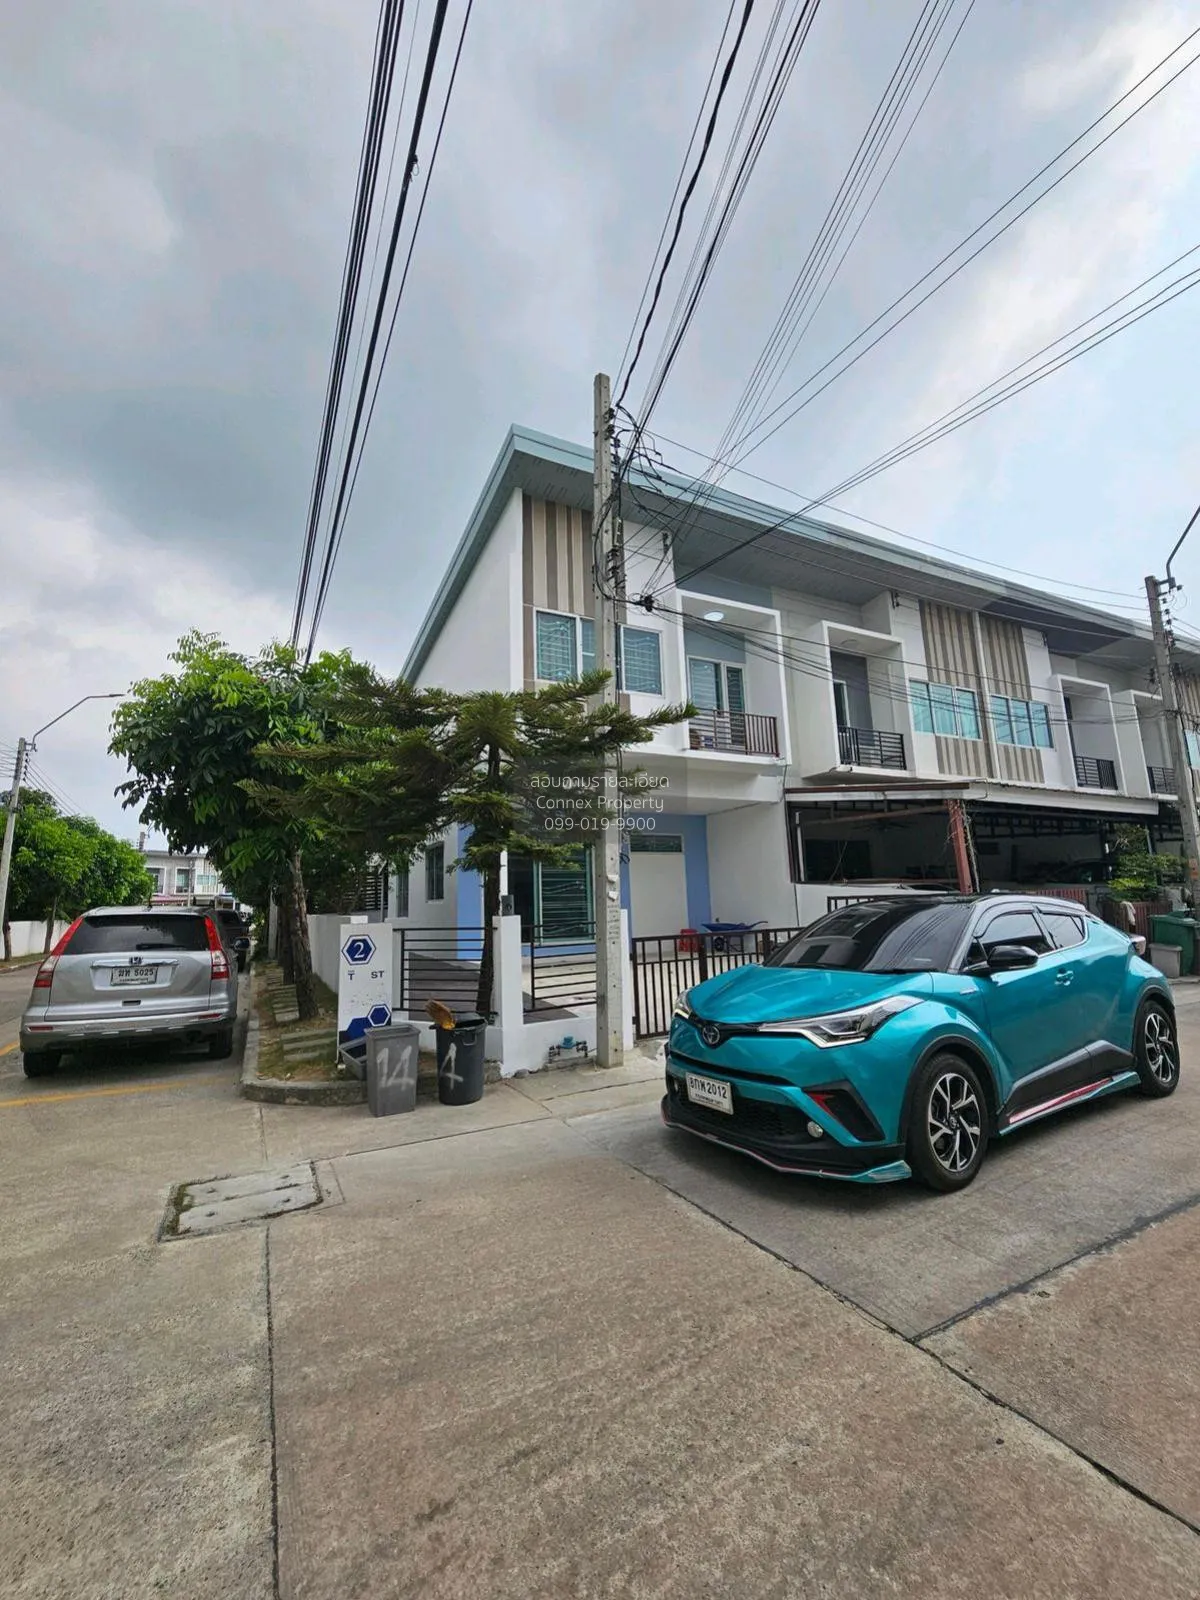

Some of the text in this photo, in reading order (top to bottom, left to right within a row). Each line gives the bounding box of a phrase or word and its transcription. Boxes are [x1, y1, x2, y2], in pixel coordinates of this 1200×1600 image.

[354, 942, 365, 958] 2
[371, 970, 385, 979] ST
[377, 1046, 415, 1091] 14
